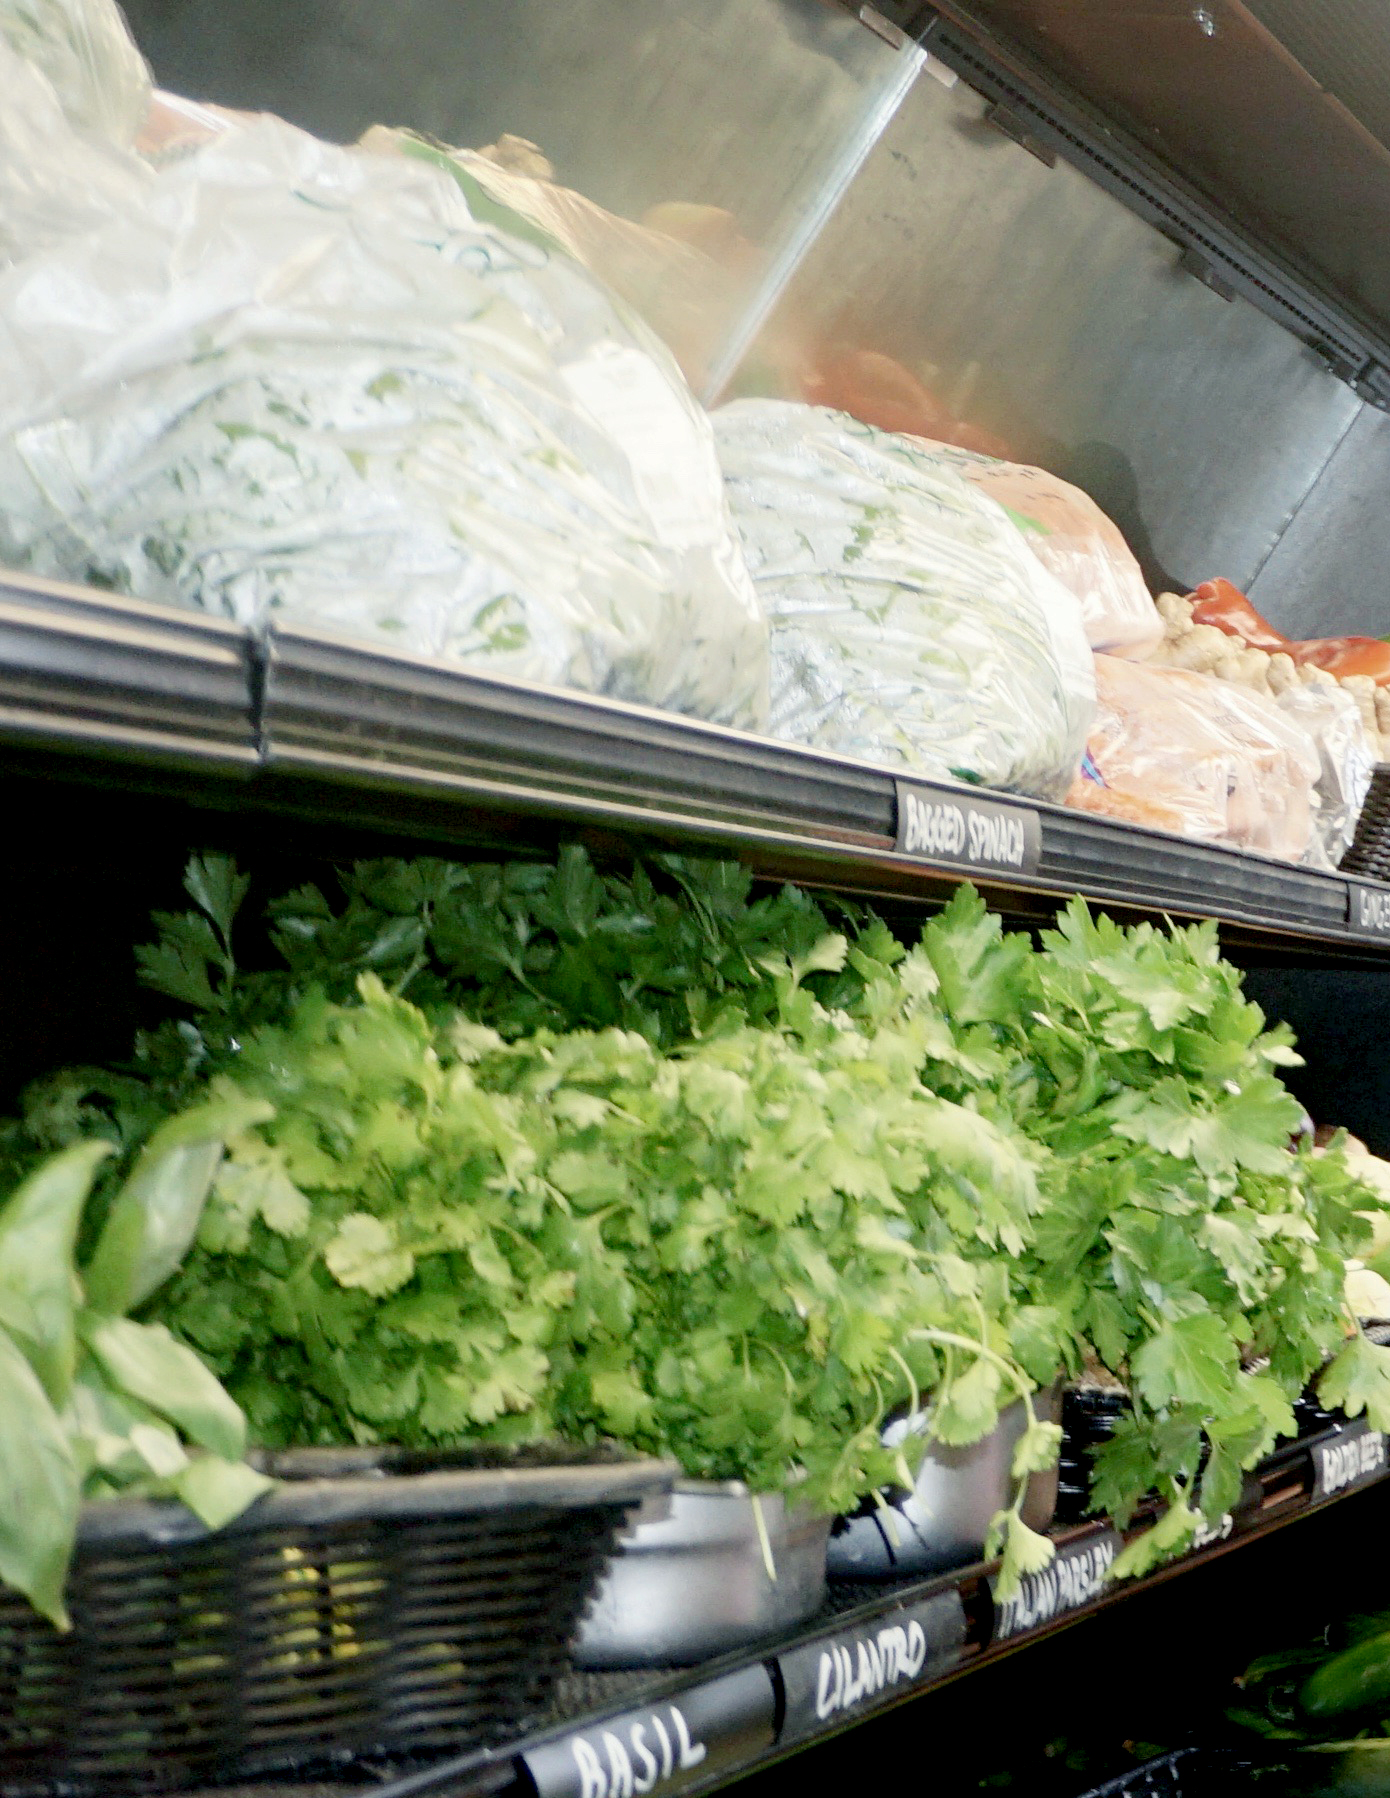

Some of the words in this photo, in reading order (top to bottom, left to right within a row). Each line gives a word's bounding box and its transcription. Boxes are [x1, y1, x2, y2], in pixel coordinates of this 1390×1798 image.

[905, 794, 966, 855] BAGGED
[968, 809, 1025, 867] SPINACH
[816, 1619, 927, 1720] CILANTRO
